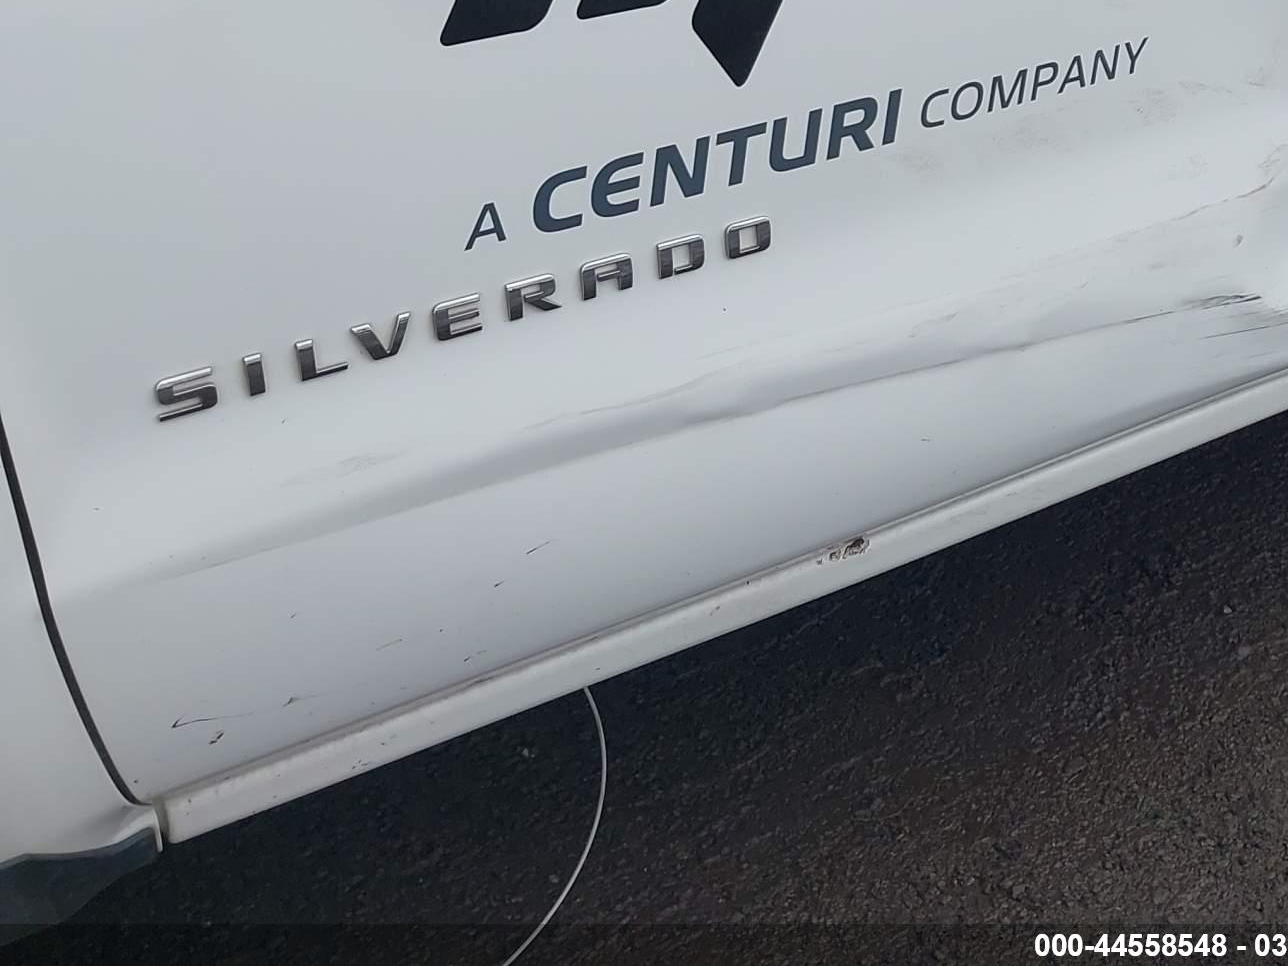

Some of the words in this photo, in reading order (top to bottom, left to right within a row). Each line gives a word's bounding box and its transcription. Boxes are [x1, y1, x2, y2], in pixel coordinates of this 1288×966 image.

[464, 202, 508, 252] A
[532, 89, 902, 233] CENTURI
[919, 37, 1149, 130] COMPANY
[154, 215, 772, 423] SILVERADO
